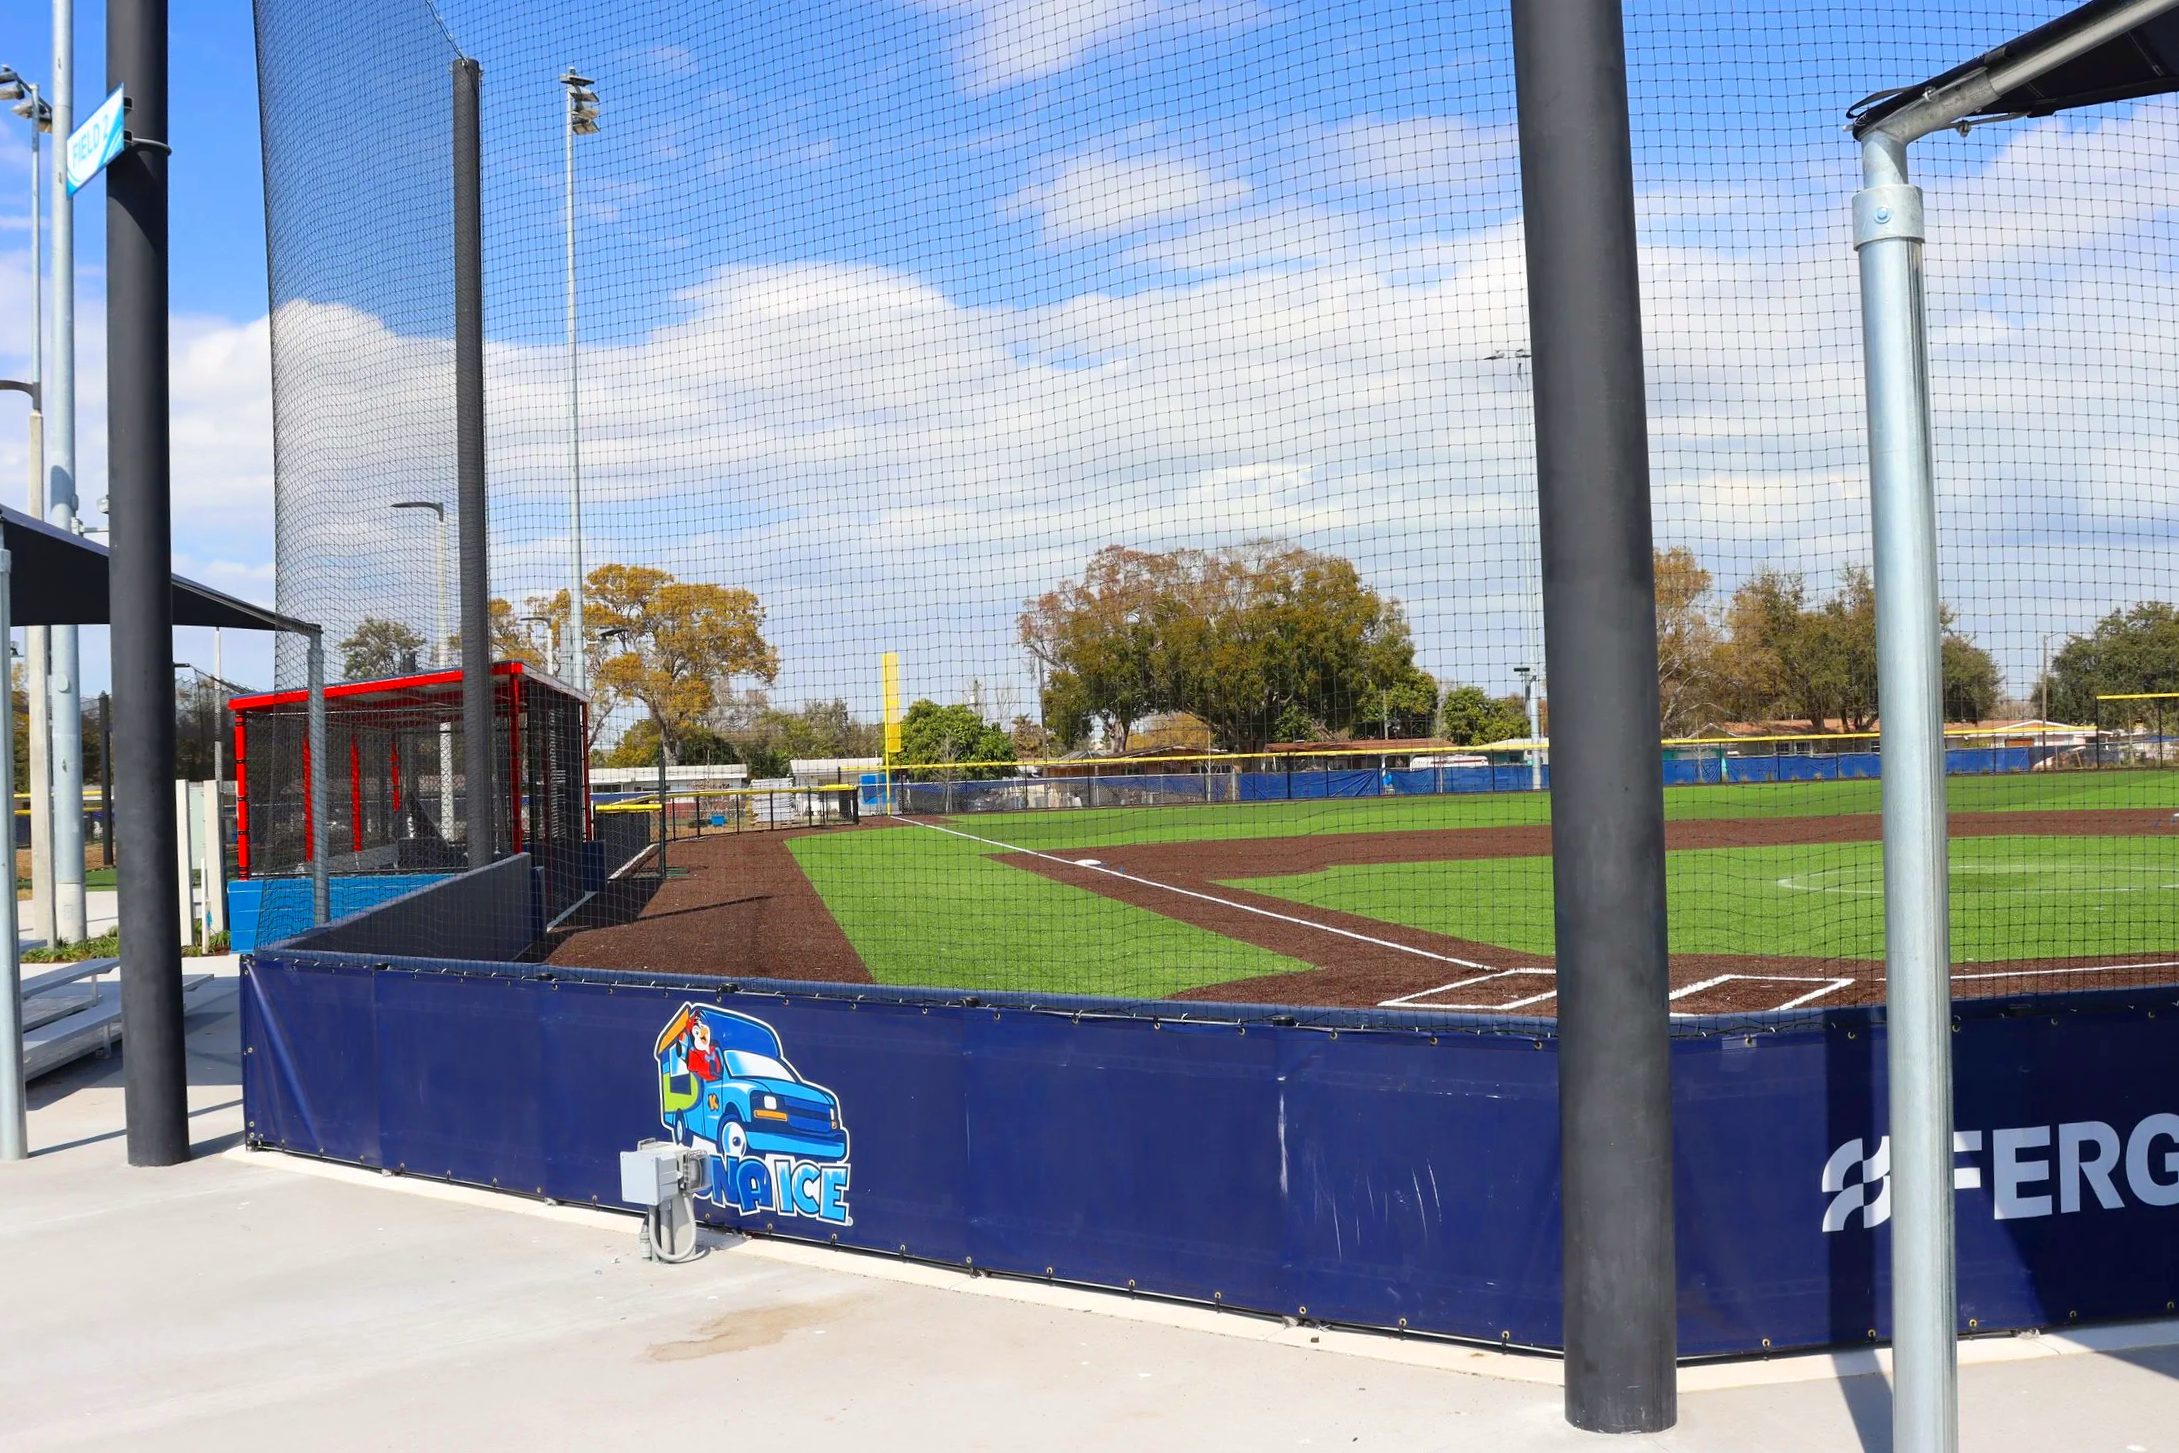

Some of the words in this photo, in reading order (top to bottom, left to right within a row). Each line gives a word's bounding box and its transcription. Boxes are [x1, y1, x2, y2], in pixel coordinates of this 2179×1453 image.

[73, 123, 100, 169] FIELD
[708, 1092, 720, 1112] K
[696, 1155, 775, 1214] NA
[775, 1157, 850, 1223] ICE
